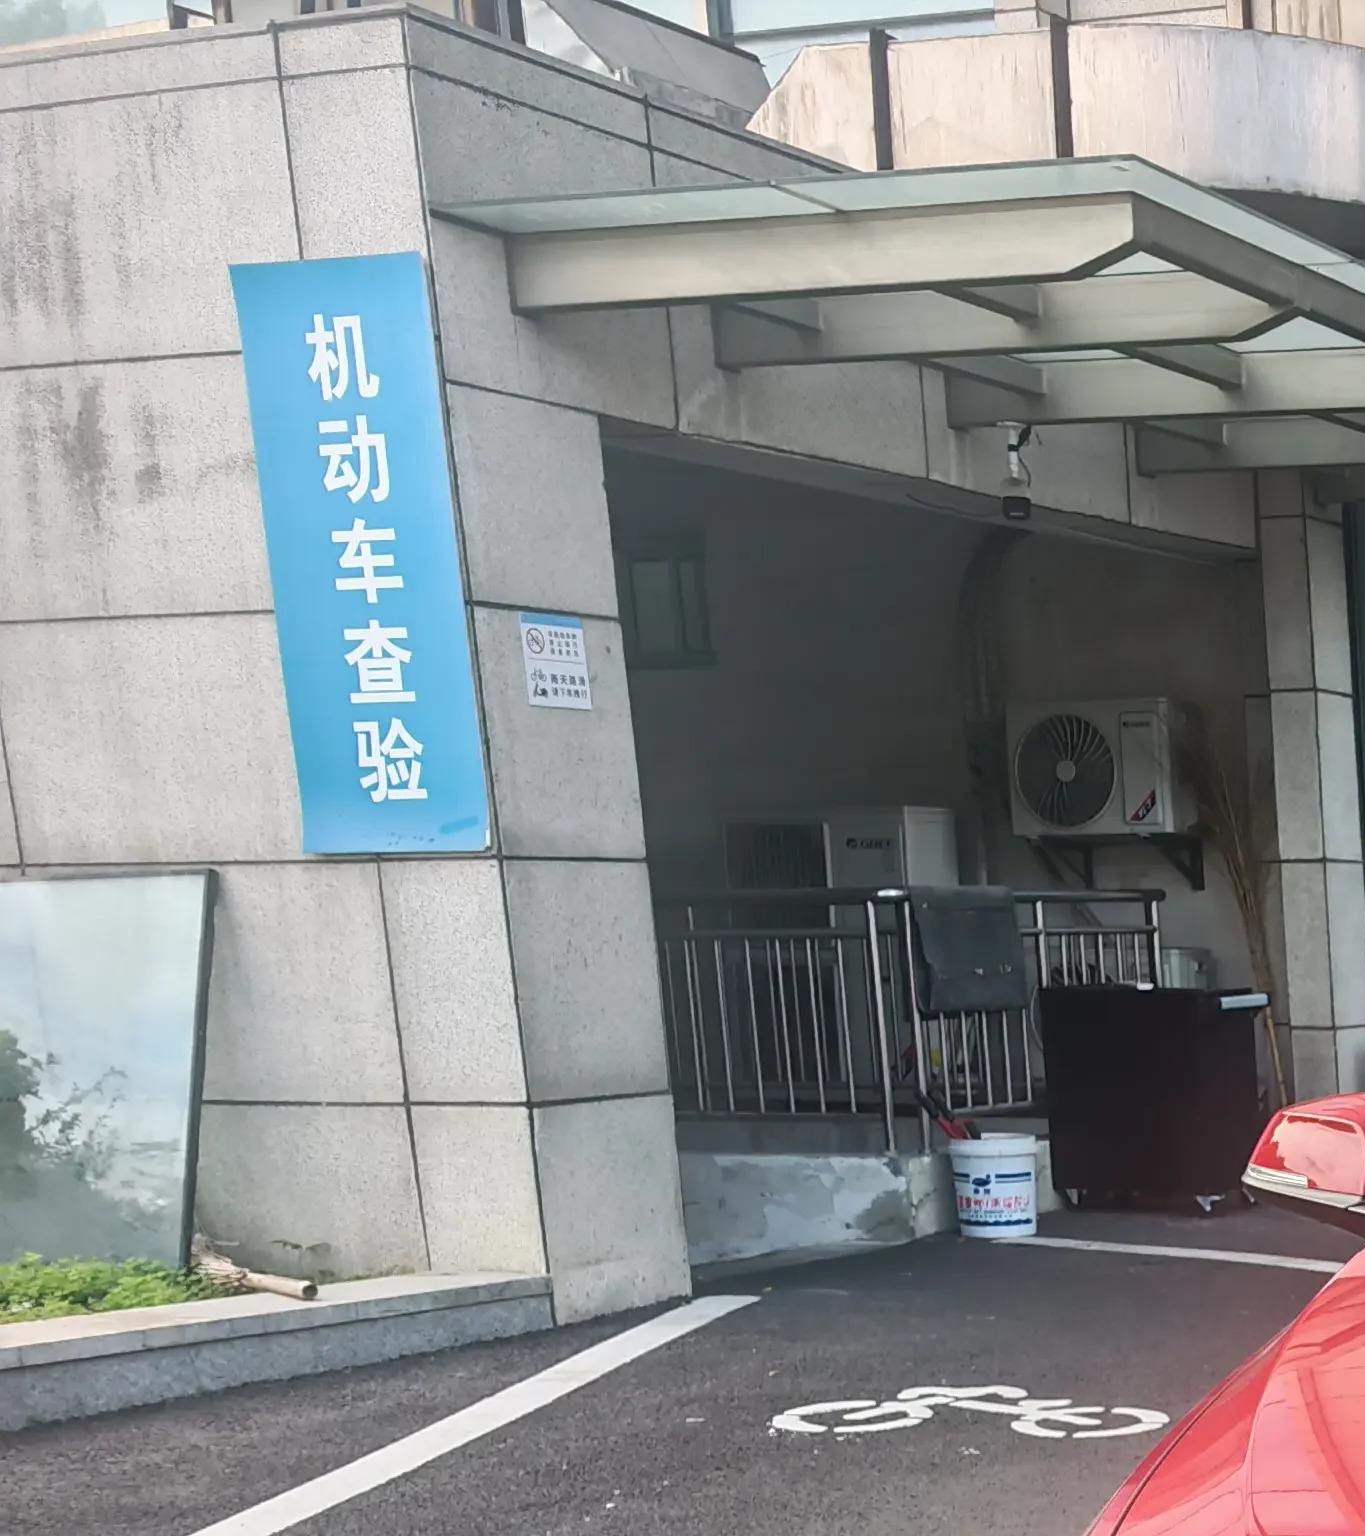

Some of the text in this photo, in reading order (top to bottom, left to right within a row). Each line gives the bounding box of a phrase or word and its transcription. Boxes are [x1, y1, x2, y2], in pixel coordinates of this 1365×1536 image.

[304, 313, 429, 803] 机动车查验
